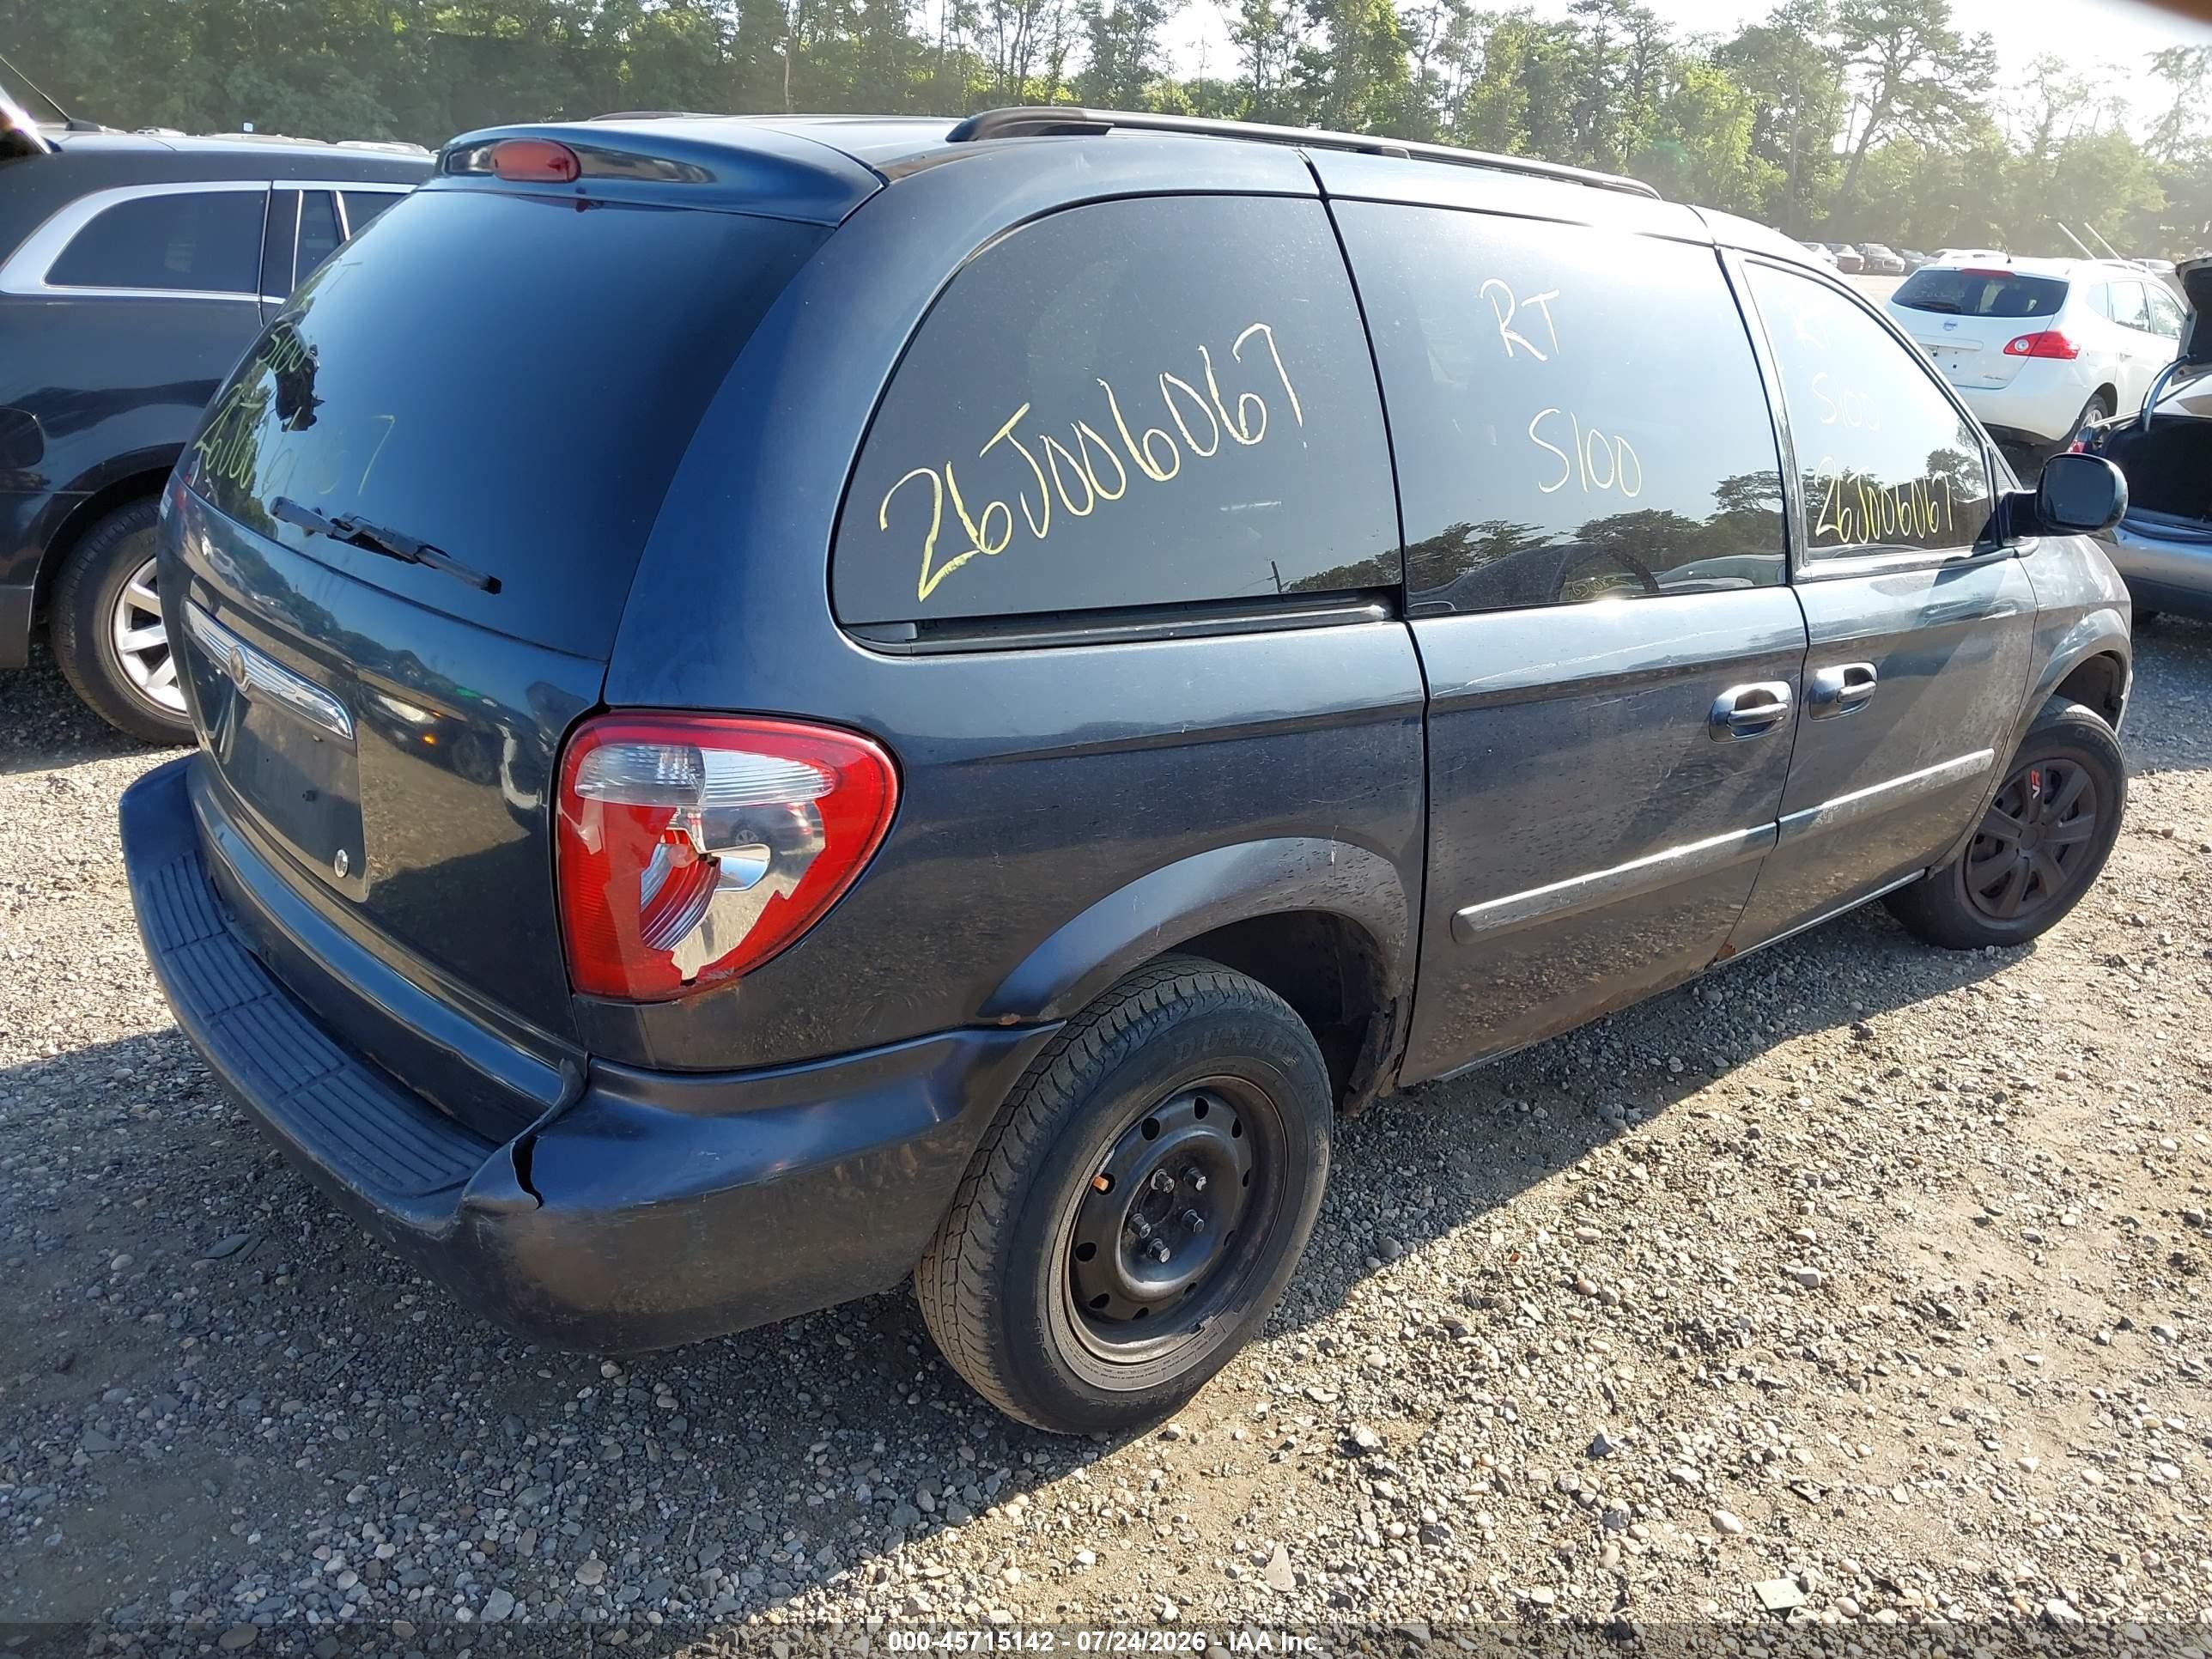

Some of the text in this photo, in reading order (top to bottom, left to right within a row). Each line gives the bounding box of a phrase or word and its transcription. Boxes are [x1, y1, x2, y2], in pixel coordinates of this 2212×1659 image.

[1480, 278, 1560, 362] RT
[1812, 372, 1882, 431] S100
[879, 322, 1304, 602] 26J006067
[1528, 408, 1641, 497] S100
[1814, 456, 1953, 544] 26J006067
